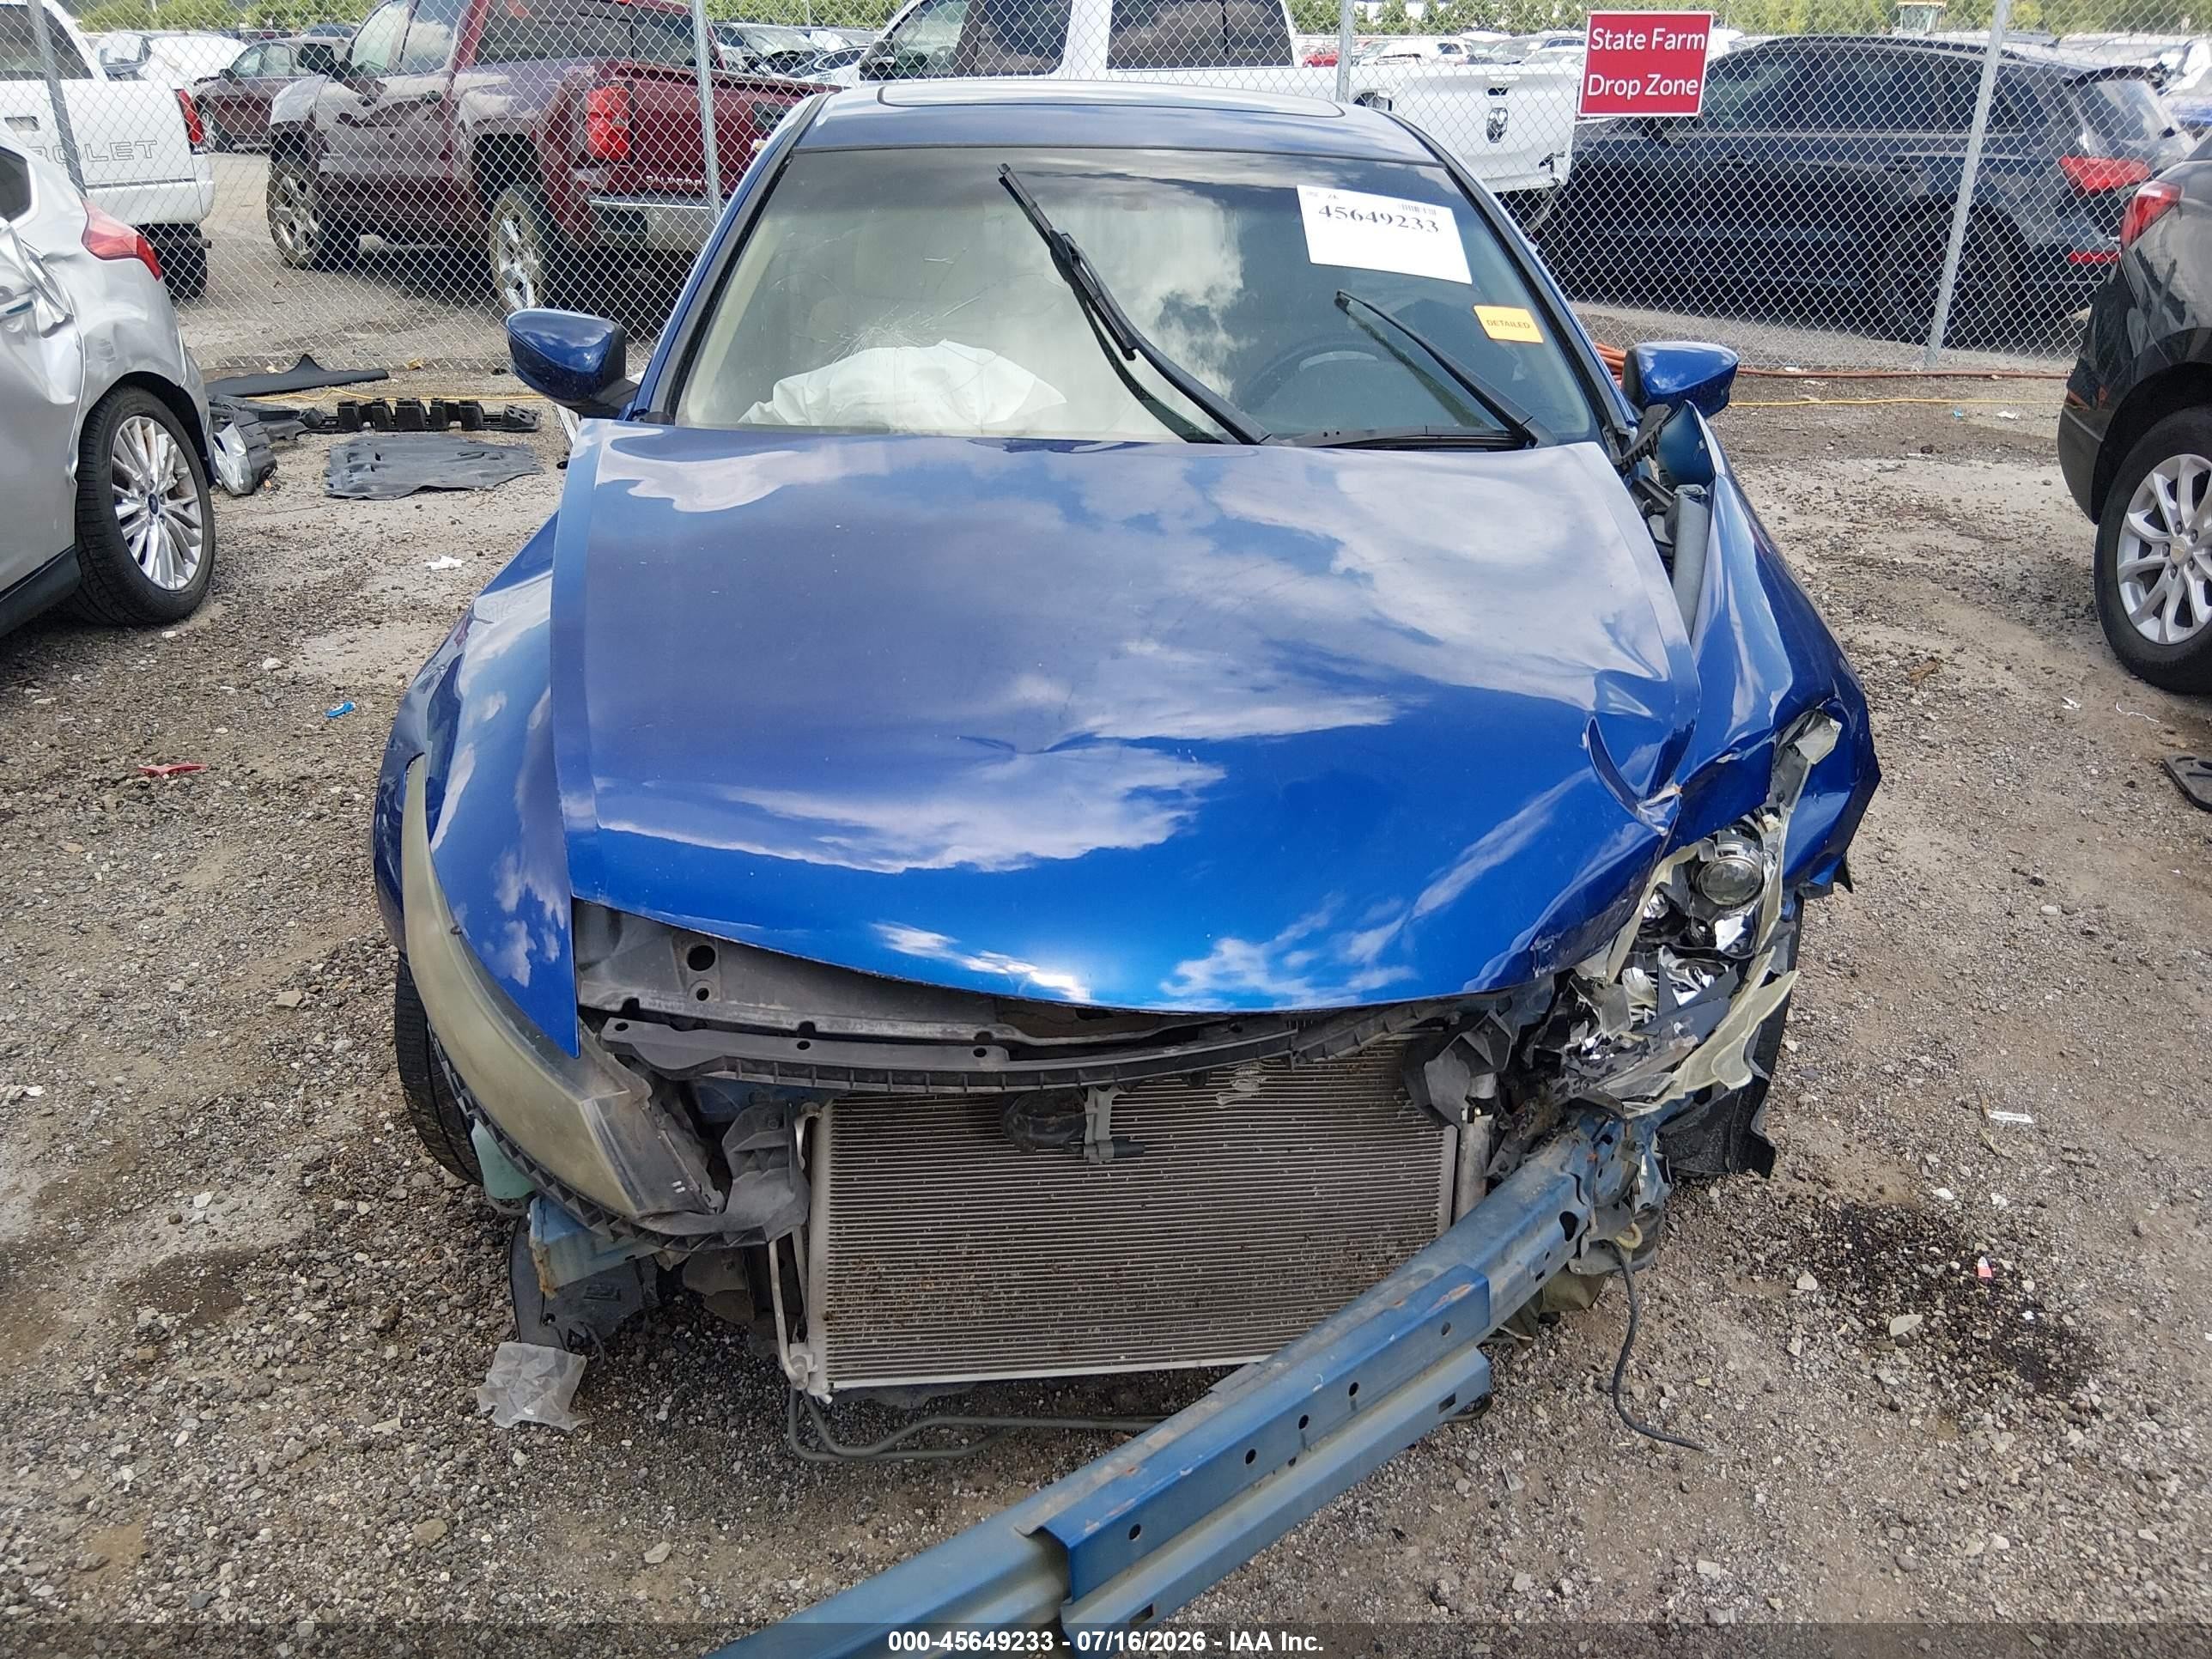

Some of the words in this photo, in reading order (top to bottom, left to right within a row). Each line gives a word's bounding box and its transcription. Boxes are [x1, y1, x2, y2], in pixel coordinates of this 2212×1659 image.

[1591, 27, 1646, 50] State
[1651, 27, 1705, 50] Farm
[1587, 74, 1640, 100] Drop
[1644, 73, 1698, 95] Zone
[1318, 204, 1440, 234] 45649233
[1486, 319, 1531, 329] DETAILED
